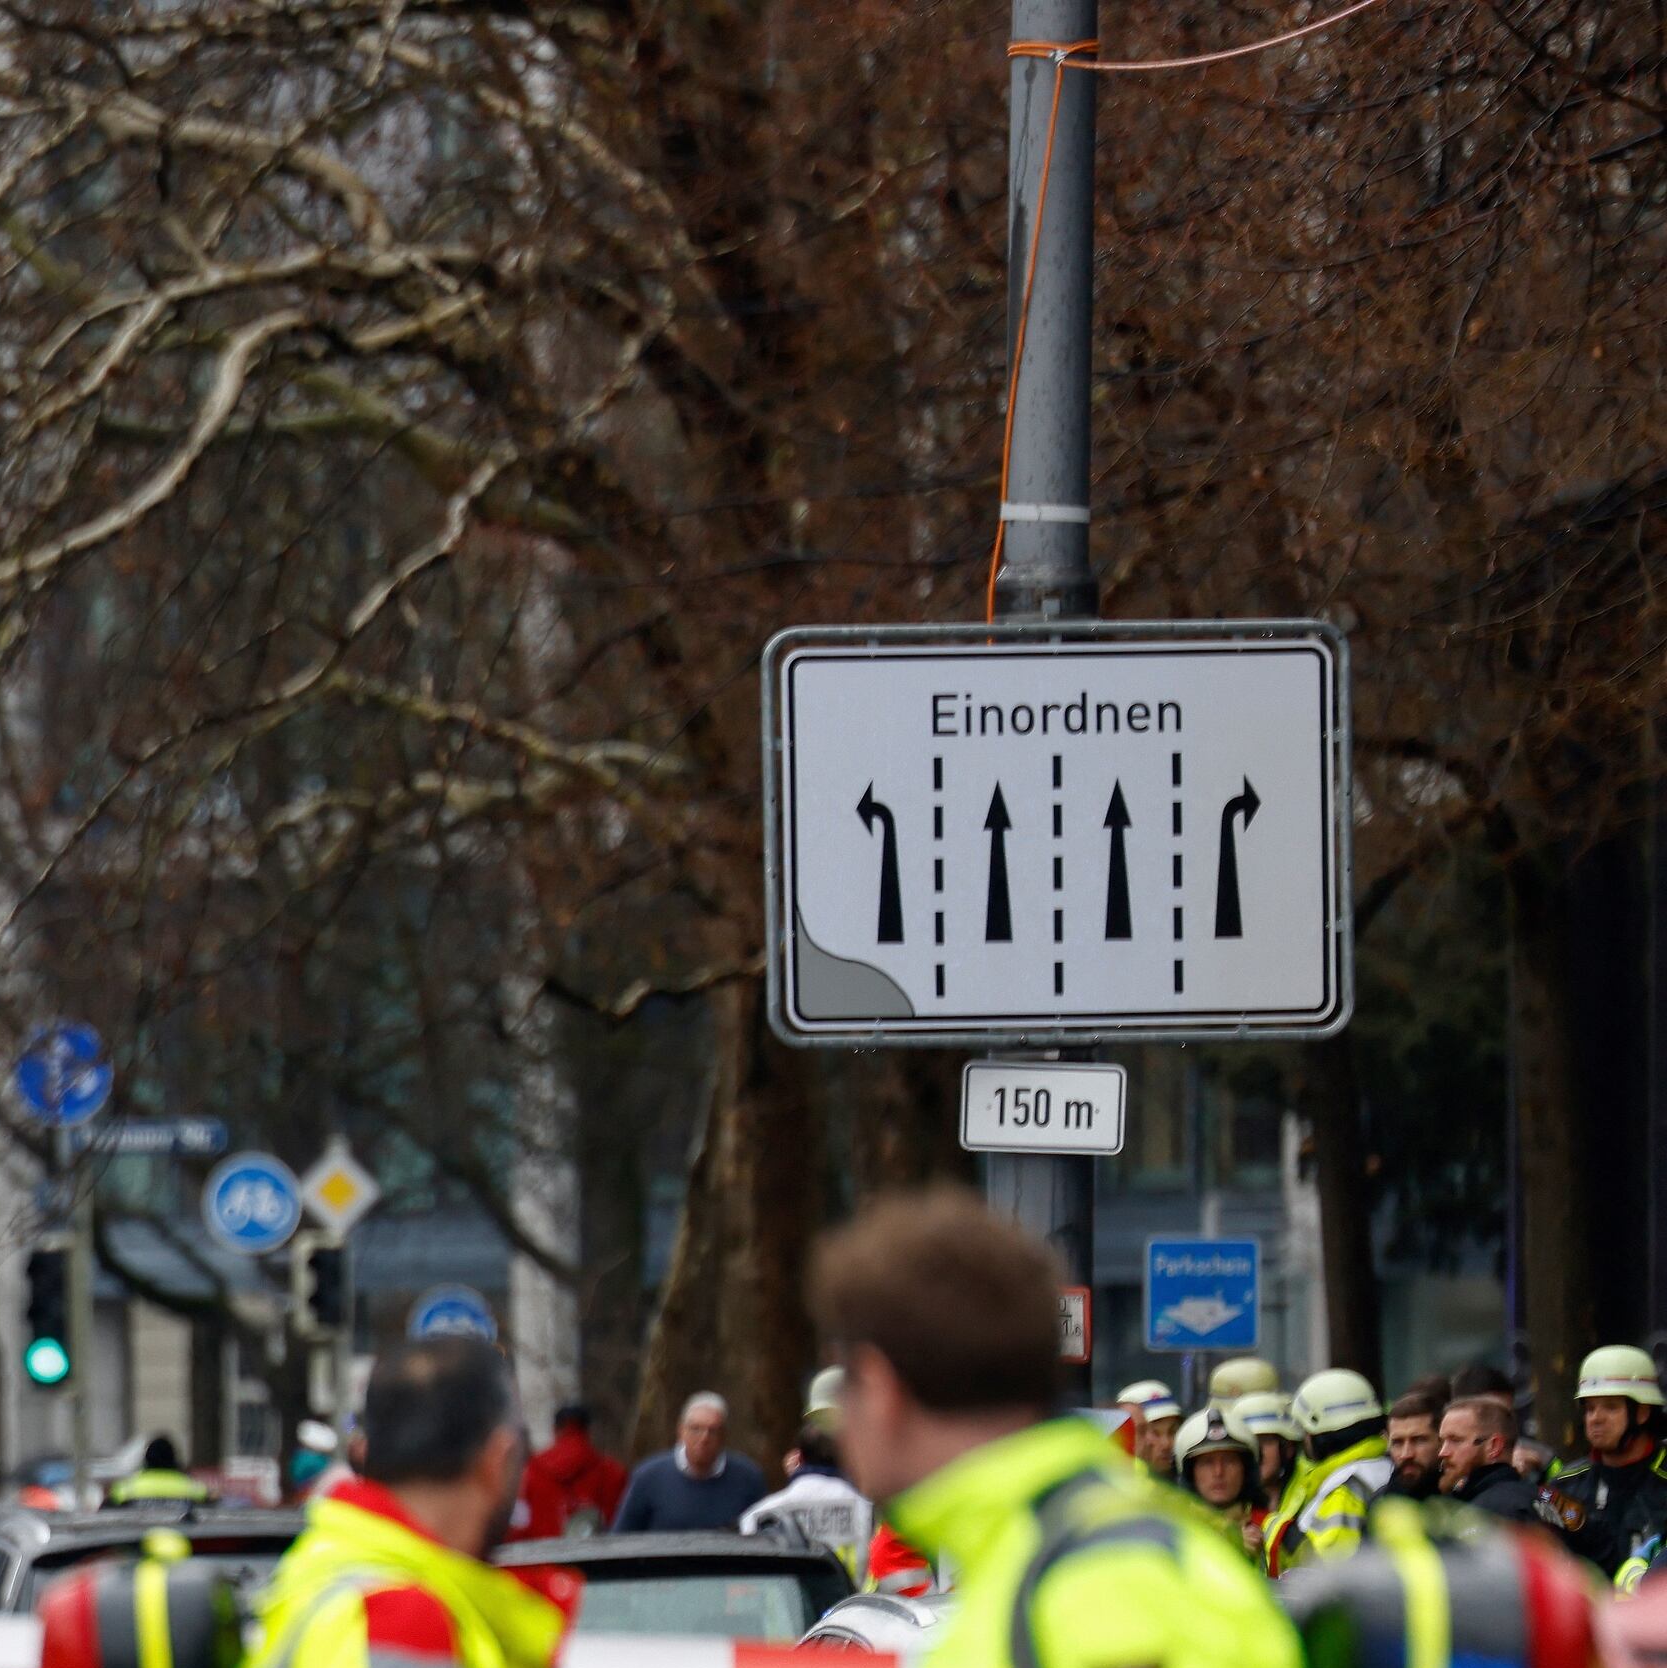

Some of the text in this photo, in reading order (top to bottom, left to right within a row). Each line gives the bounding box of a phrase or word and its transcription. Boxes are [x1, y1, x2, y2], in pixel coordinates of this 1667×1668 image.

[931, 690, 1182, 738] Einordnen
[994, 1087, 1093, 1129] 150 m
